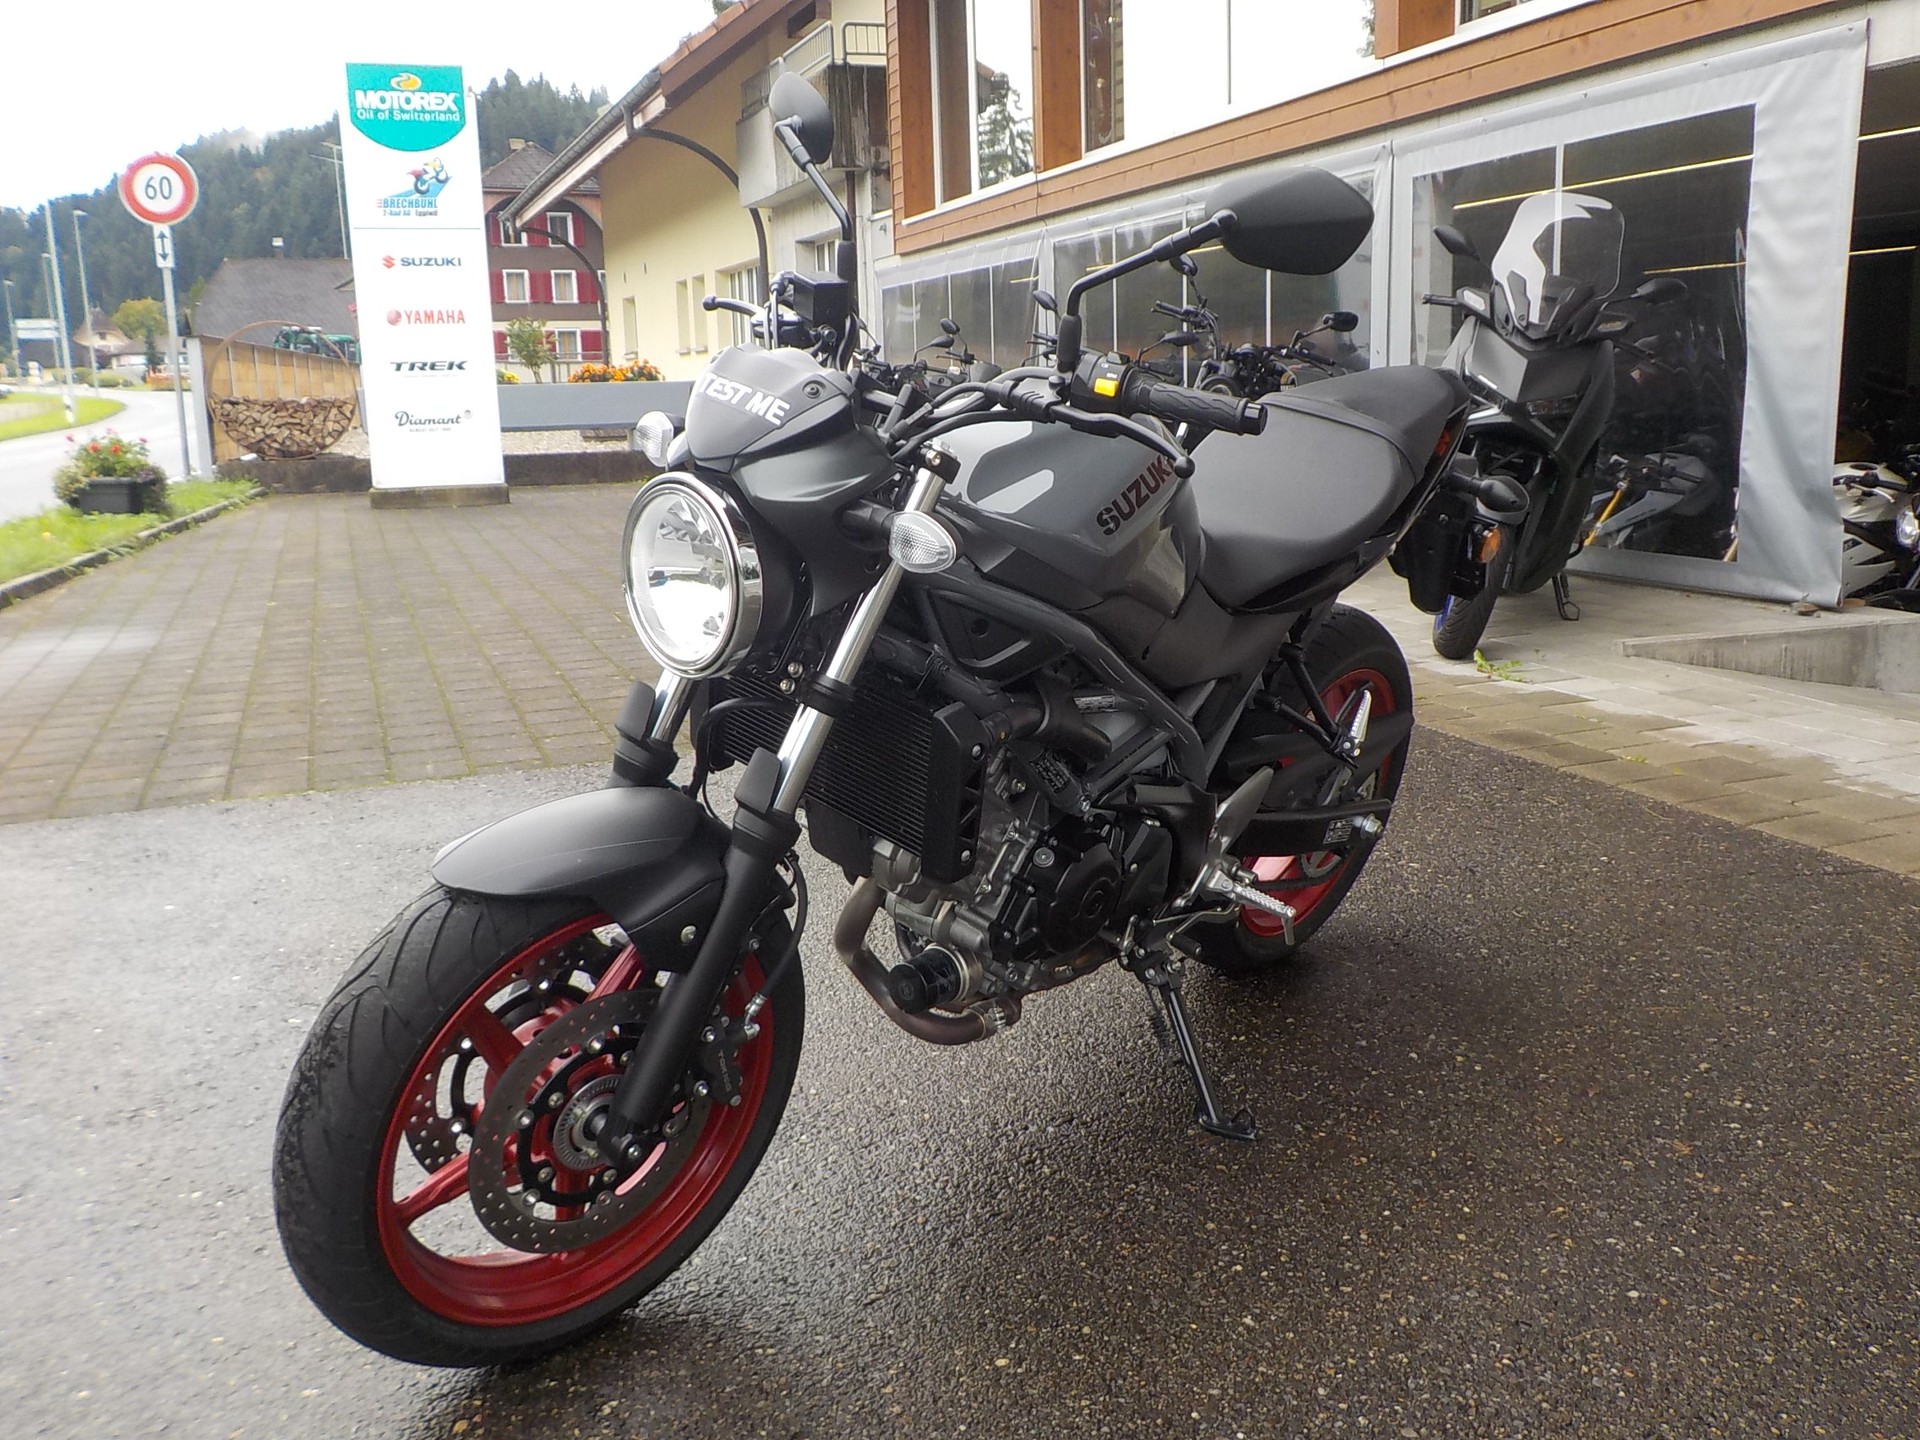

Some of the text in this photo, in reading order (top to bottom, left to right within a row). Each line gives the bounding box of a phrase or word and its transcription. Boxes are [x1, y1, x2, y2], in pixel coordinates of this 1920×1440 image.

[354, 89, 461, 111] MOTOREX
[356, 109, 461, 122] Oil of Switzerland
[144, 175, 173, 200] 60
[400, 256, 462, 267] SUZUKI
[404, 309, 466, 325] YAMAHA
[390, 360, 468, 372] TREK
[699, 372, 791, 426] TEST ME
[394, 410, 462, 427] Diamant
